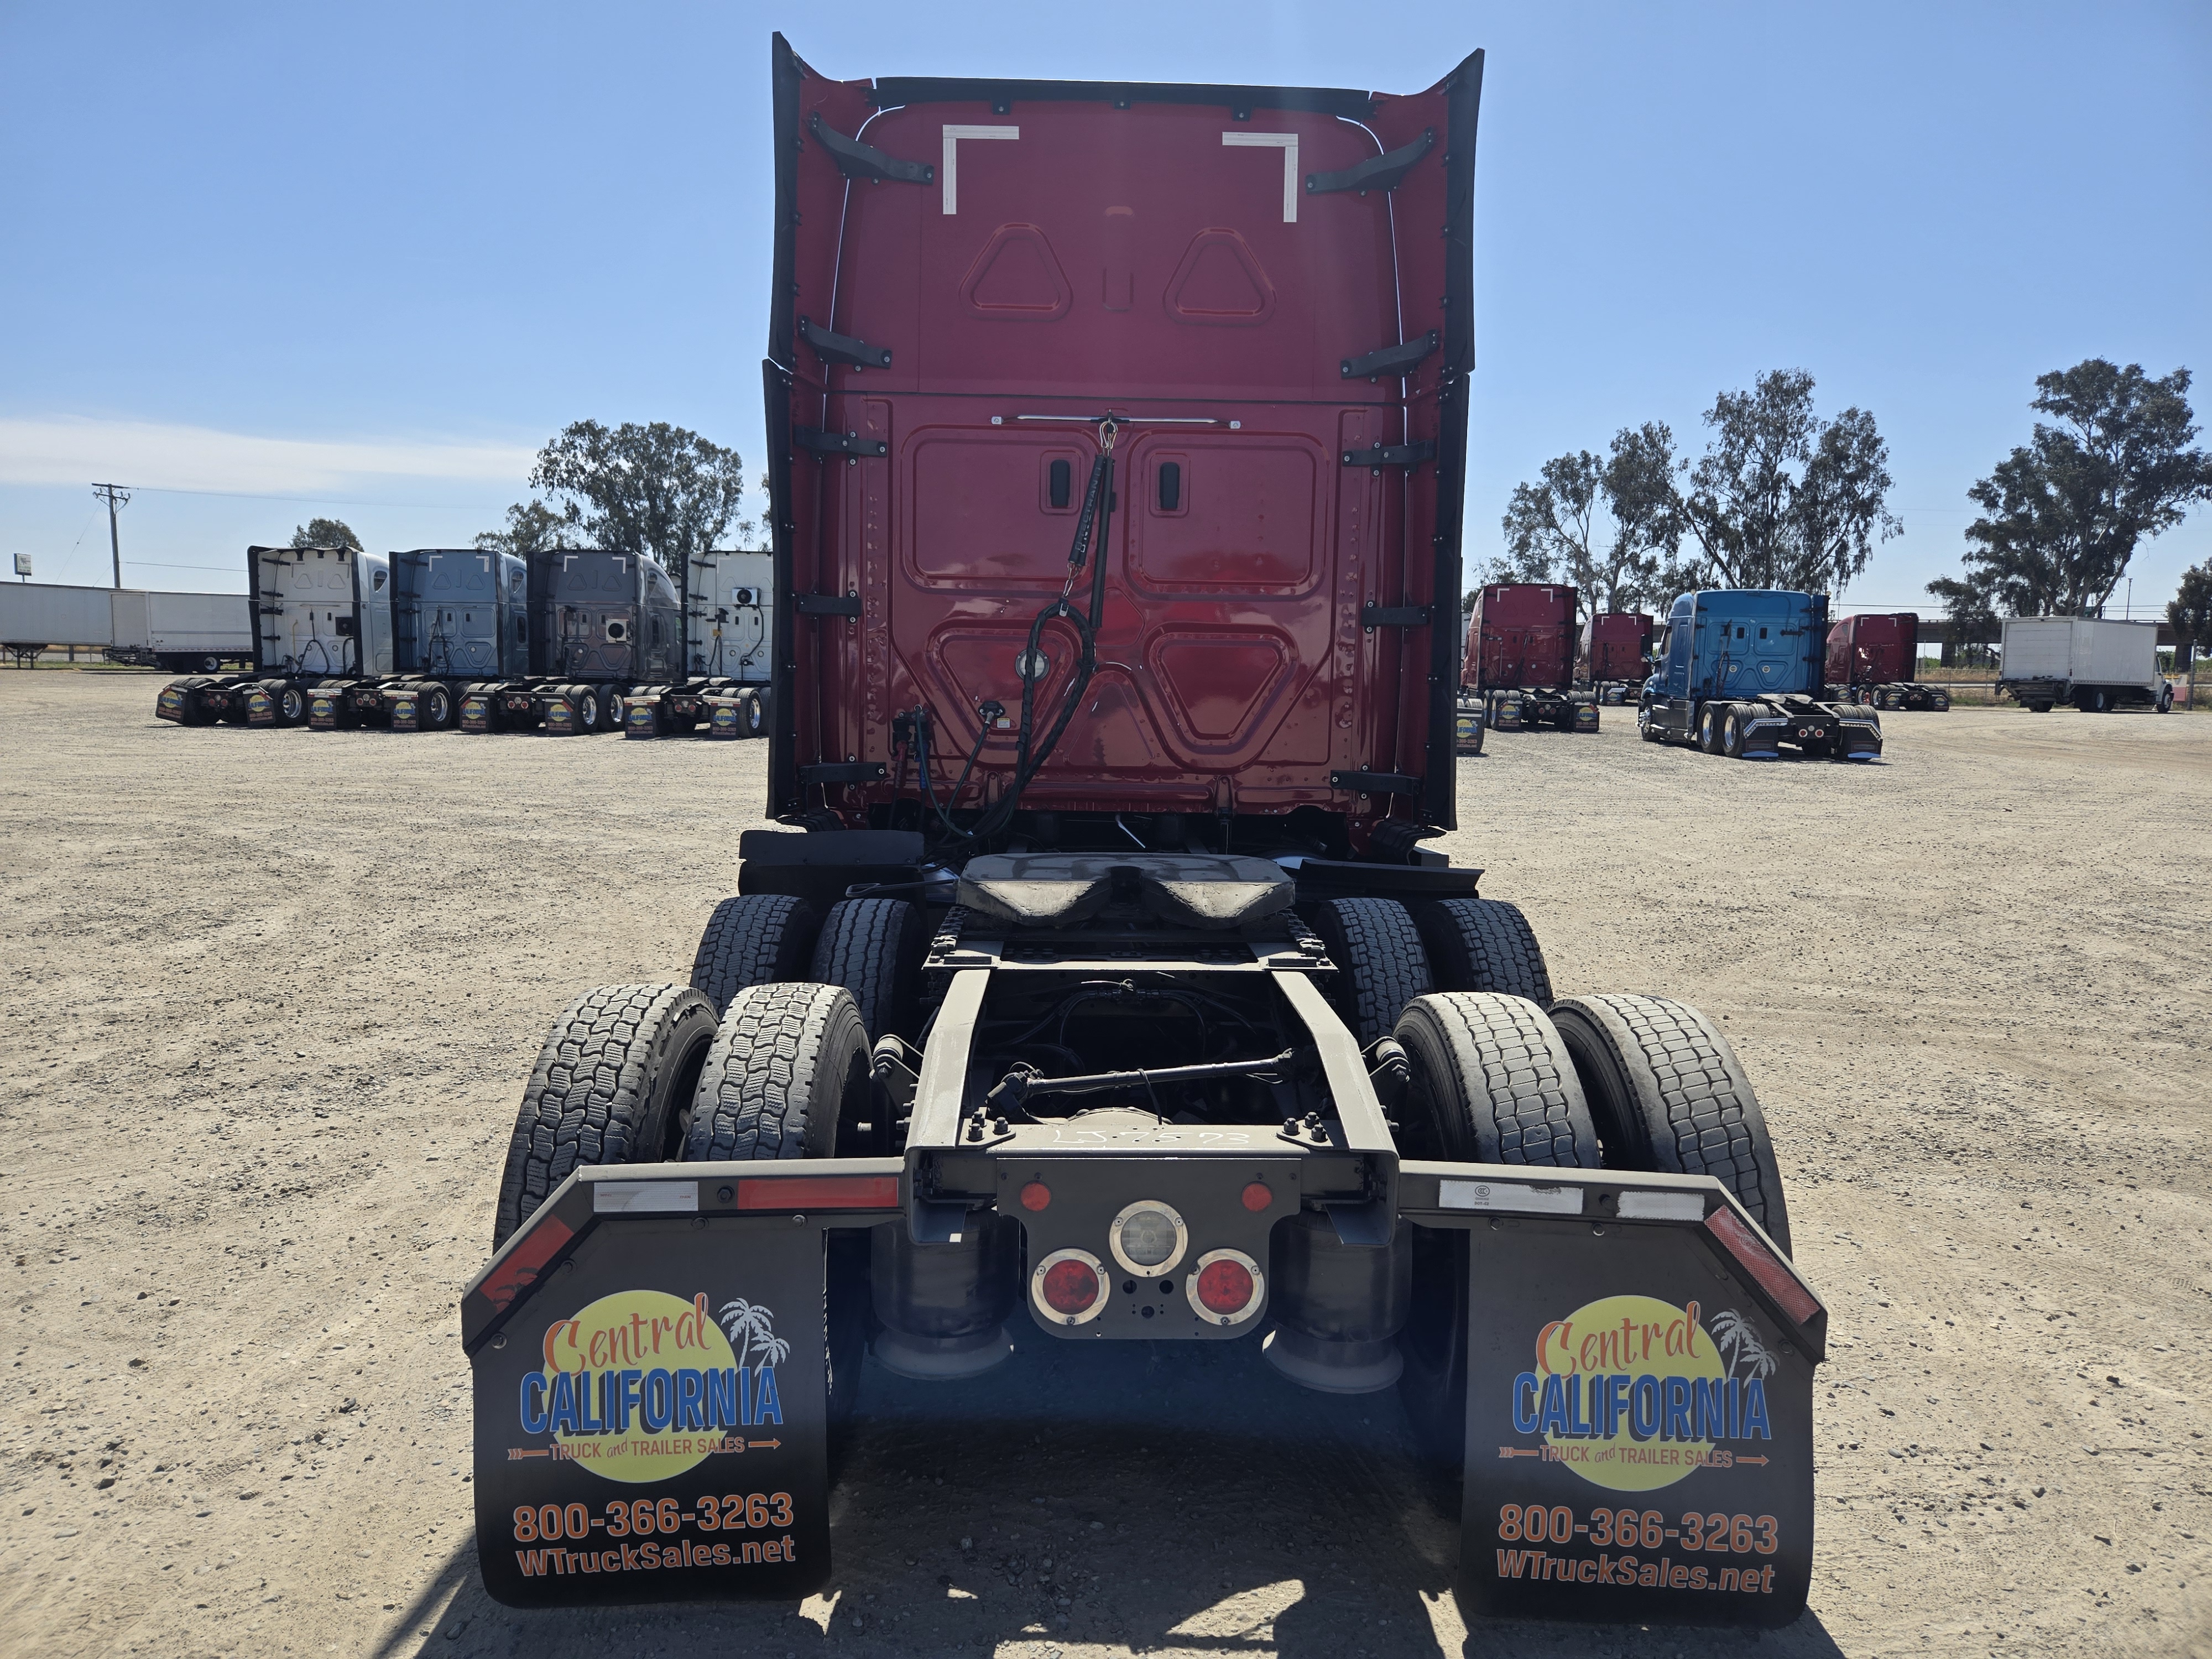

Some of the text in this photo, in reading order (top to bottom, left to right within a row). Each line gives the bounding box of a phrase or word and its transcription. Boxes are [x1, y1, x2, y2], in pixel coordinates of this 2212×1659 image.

[544, 1292, 712, 1376] Central
[1536, 1300, 1700, 1380] Central
[520, 1366, 784, 1434] CALIFORNIA
[1512, 1372, 1772, 1442] CALIFORNIA
[550, 1437, 745, 1460] TRUCK and TRAILER SALES
[1540, 1442, 1733, 1468] TRUCK and TRAILER SALES
[513, 1493, 794, 1542] 800-366-3263
[1498, 1504, 1779, 1555] 800-366-3263
[516, 1536, 796, 1577] WTruckSales.net
[1496, 1548, 1775, 1594] WTruckSales.net
